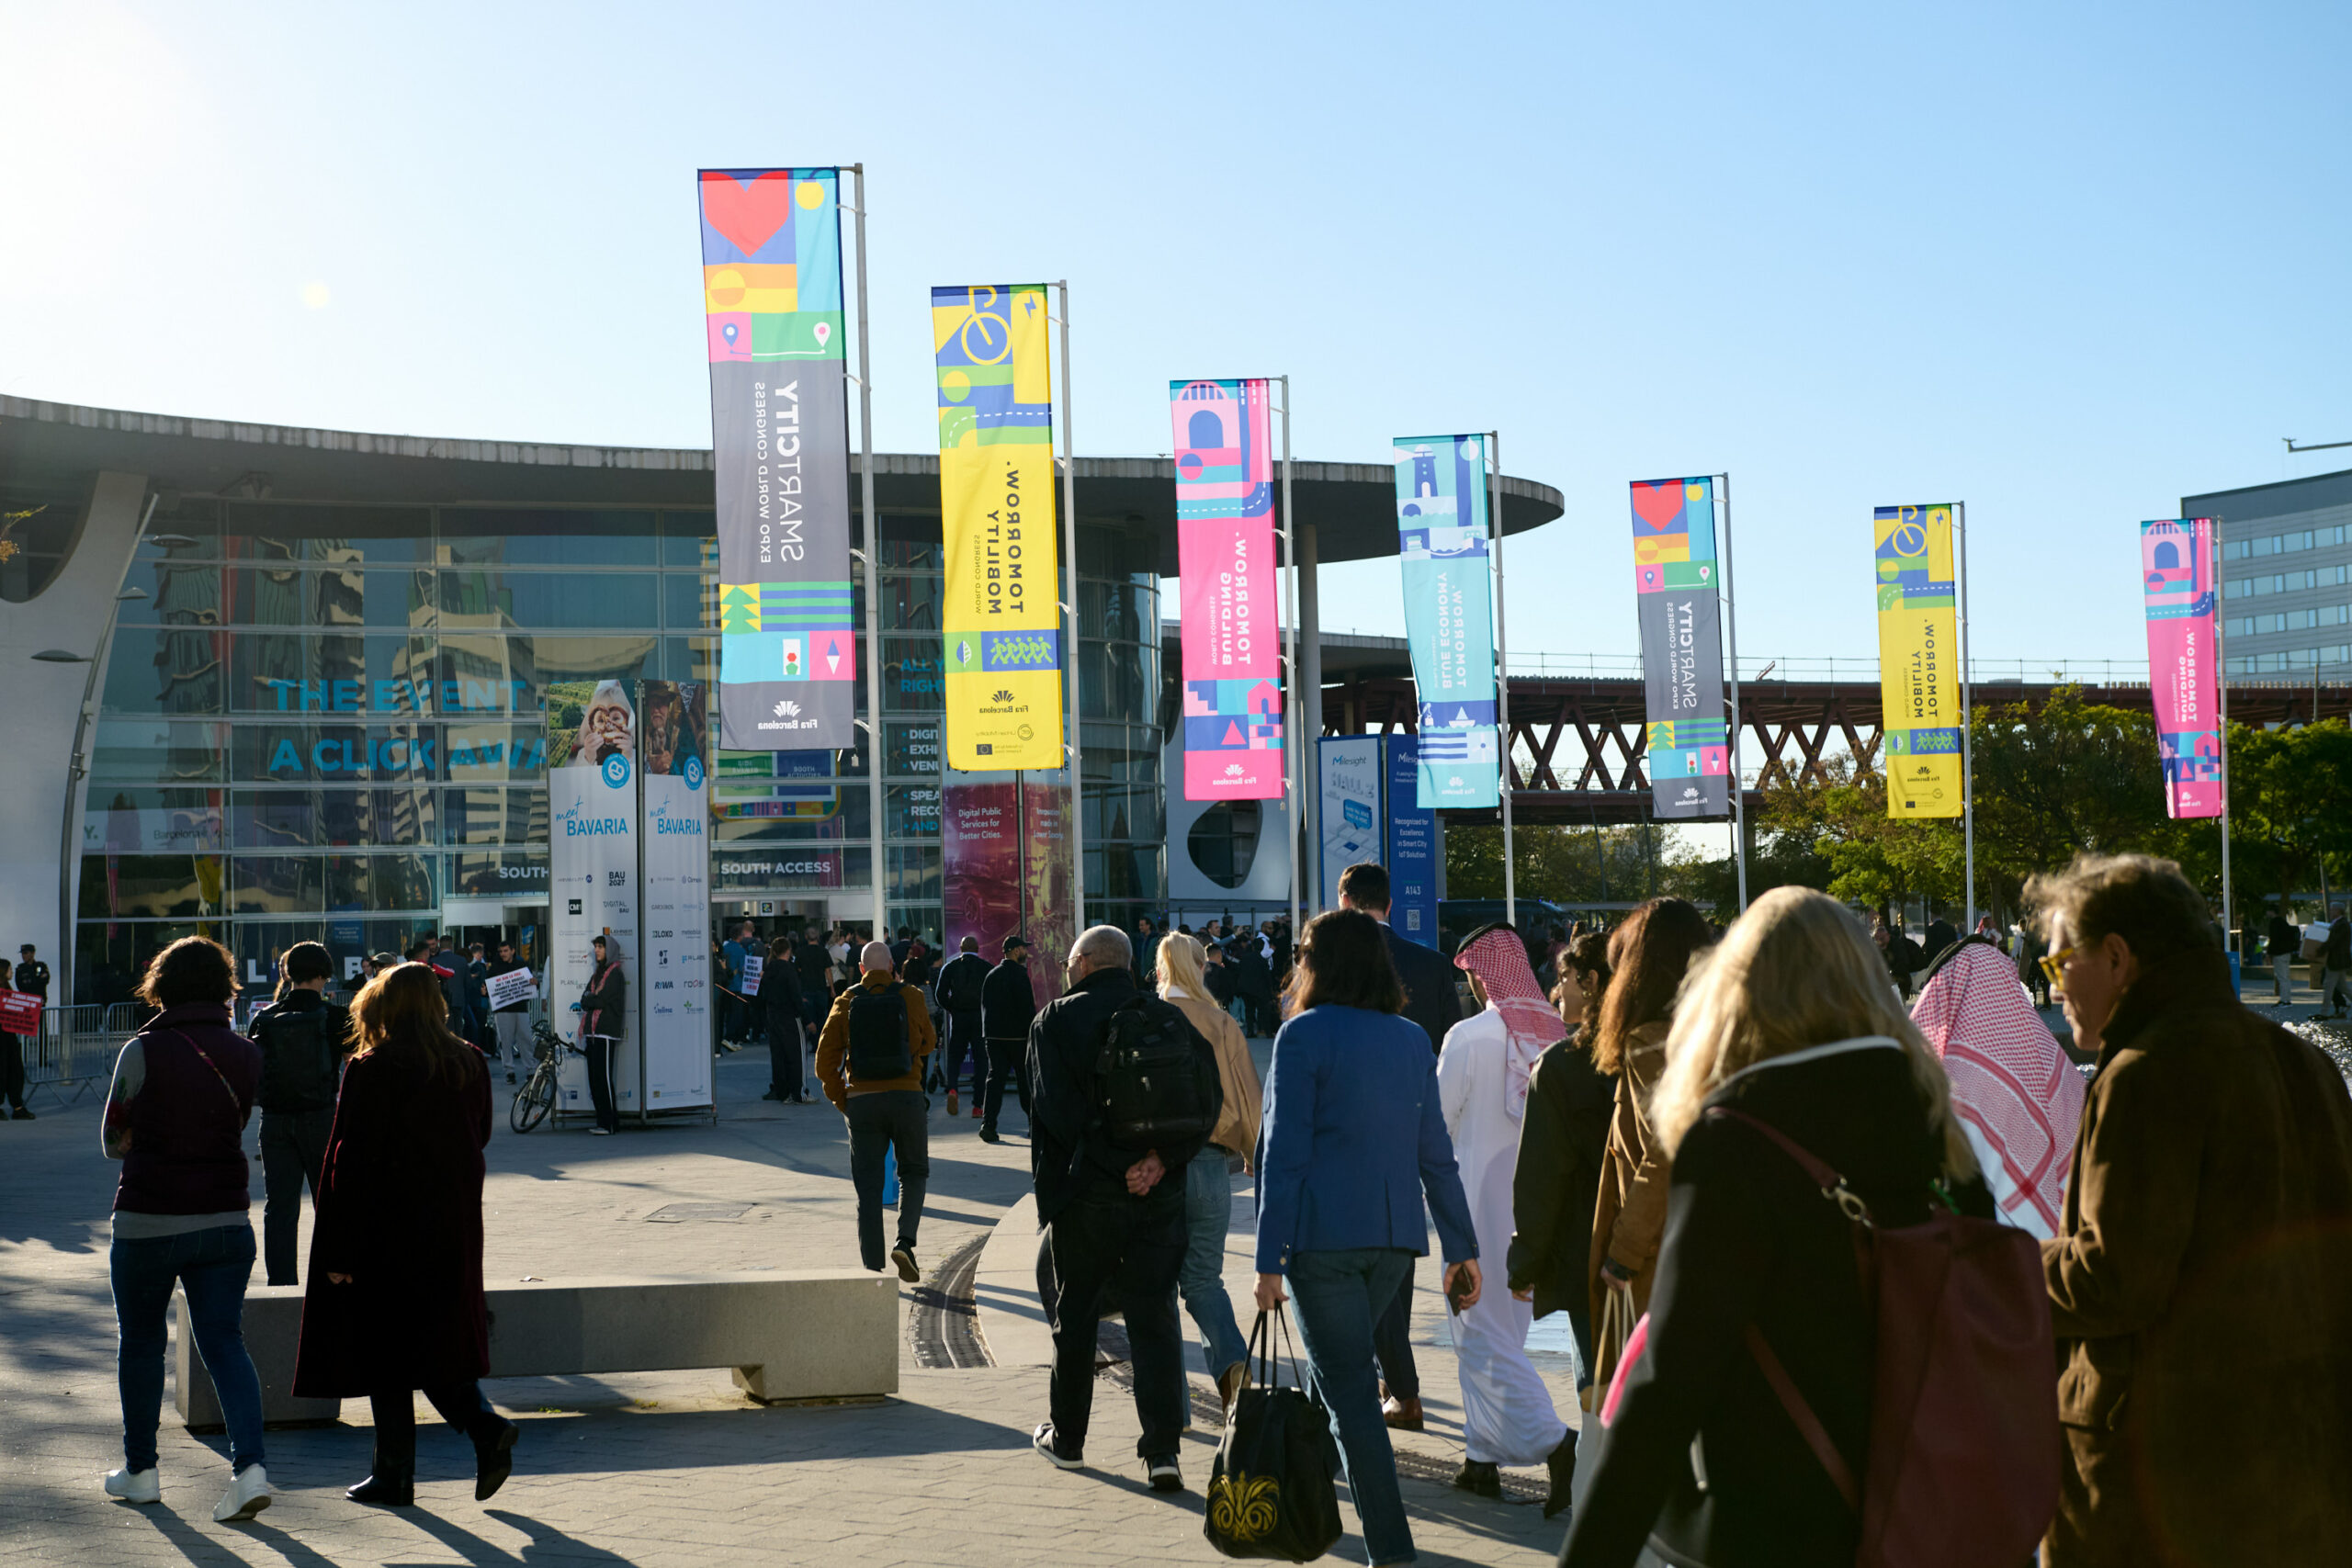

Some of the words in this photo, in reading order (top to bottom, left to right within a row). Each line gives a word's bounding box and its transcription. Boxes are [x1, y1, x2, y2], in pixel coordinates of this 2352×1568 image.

[899, 659, 932, 671] ALL
[267, 680, 359, 711] THE
[374, 680, 526, 711] EVENT
[268, 739, 304, 772] A
[311, 739, 436, 772] CLICK
[1332, 755, 1367, 767] Milesight
[556, 795, 583, 822] meet
[650, 794, 671, 818] meet
[958, 808, 980, 819] Digital
[981, 807, 1002, 817] Public
[566, 818, 628, 837] BAVARIA
[658, 818, 702, 836] BAVARIA
[911, 821, 938, 831] AND
[961, 820, 989, 829] Services
[989, 818, 1000, 827] for
[153, 829, 200, 840] Barcelona
[959, 831, 979, 840] Better
[981, 830, 1002, 839] Cities.
[1417, 840, 1428, 849] City
[1406, 851, 1427, 859] Solution
[499, 866, 549, 879] SOUTH
[721, 863, 771, 875] SOUTH
[775, 862, 831, 874] ACCESS
[608, 871, 626, 879] BAU
[1405, 886, 1421, 896] A143
[654, 981, 674, 990] RIWA
